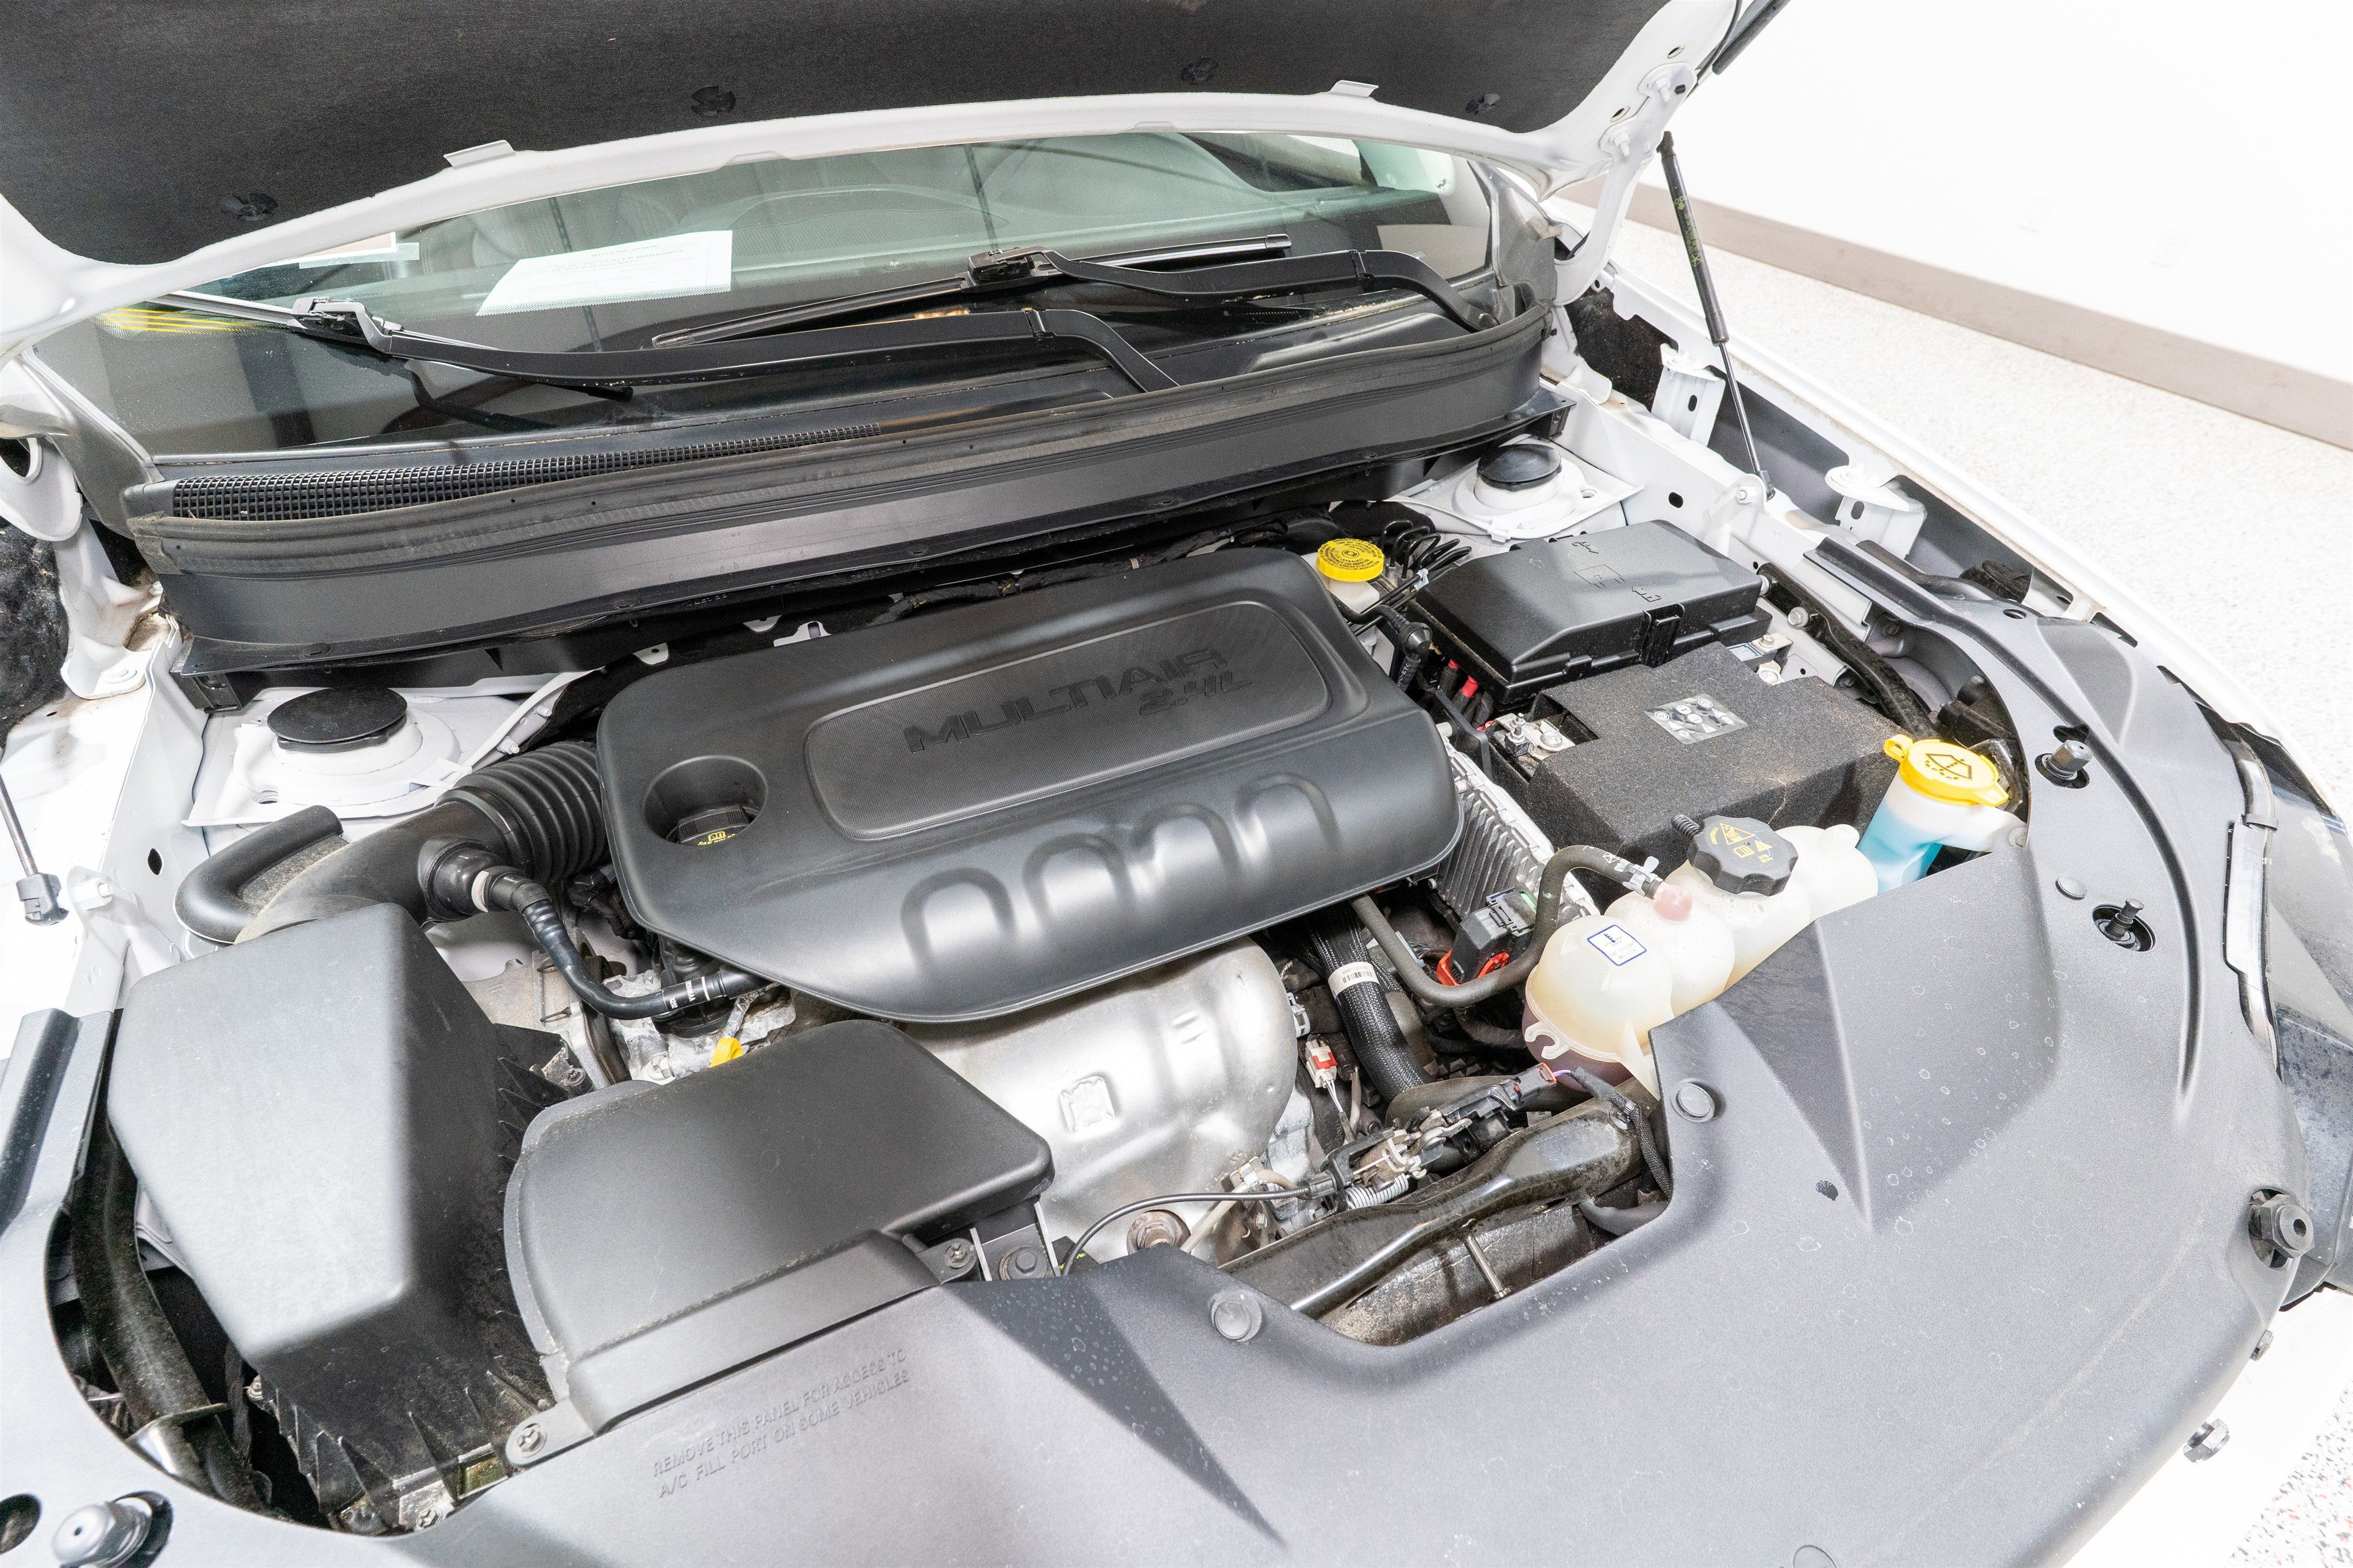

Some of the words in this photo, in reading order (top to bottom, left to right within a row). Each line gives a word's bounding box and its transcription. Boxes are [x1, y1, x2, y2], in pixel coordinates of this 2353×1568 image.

[902, 647, 1229, 754] MULTIAIR
[1139, 670, 1252, 717] 2.4L
[654, 1437, 715, 1477] REMOVE
[718, 1421, 750, 1446] THIS
[754, 1402, 800, 1430] PANEL
[803, 1384, 831, 1407] FOR
[832, 1358, 886, 1394] ACCESS
[887, 1348, 906, 1366] TO
[659, 1473, 688, 1498] A/C
[696, 1457, 726, 1481] FILL
[731, 1435, 767, 1463] PORT
[774, 1422, 796, 1444] ON
[800, 1401, 840, 1431] SOME
[846, 1369, 909, 1410] VEHICLES
